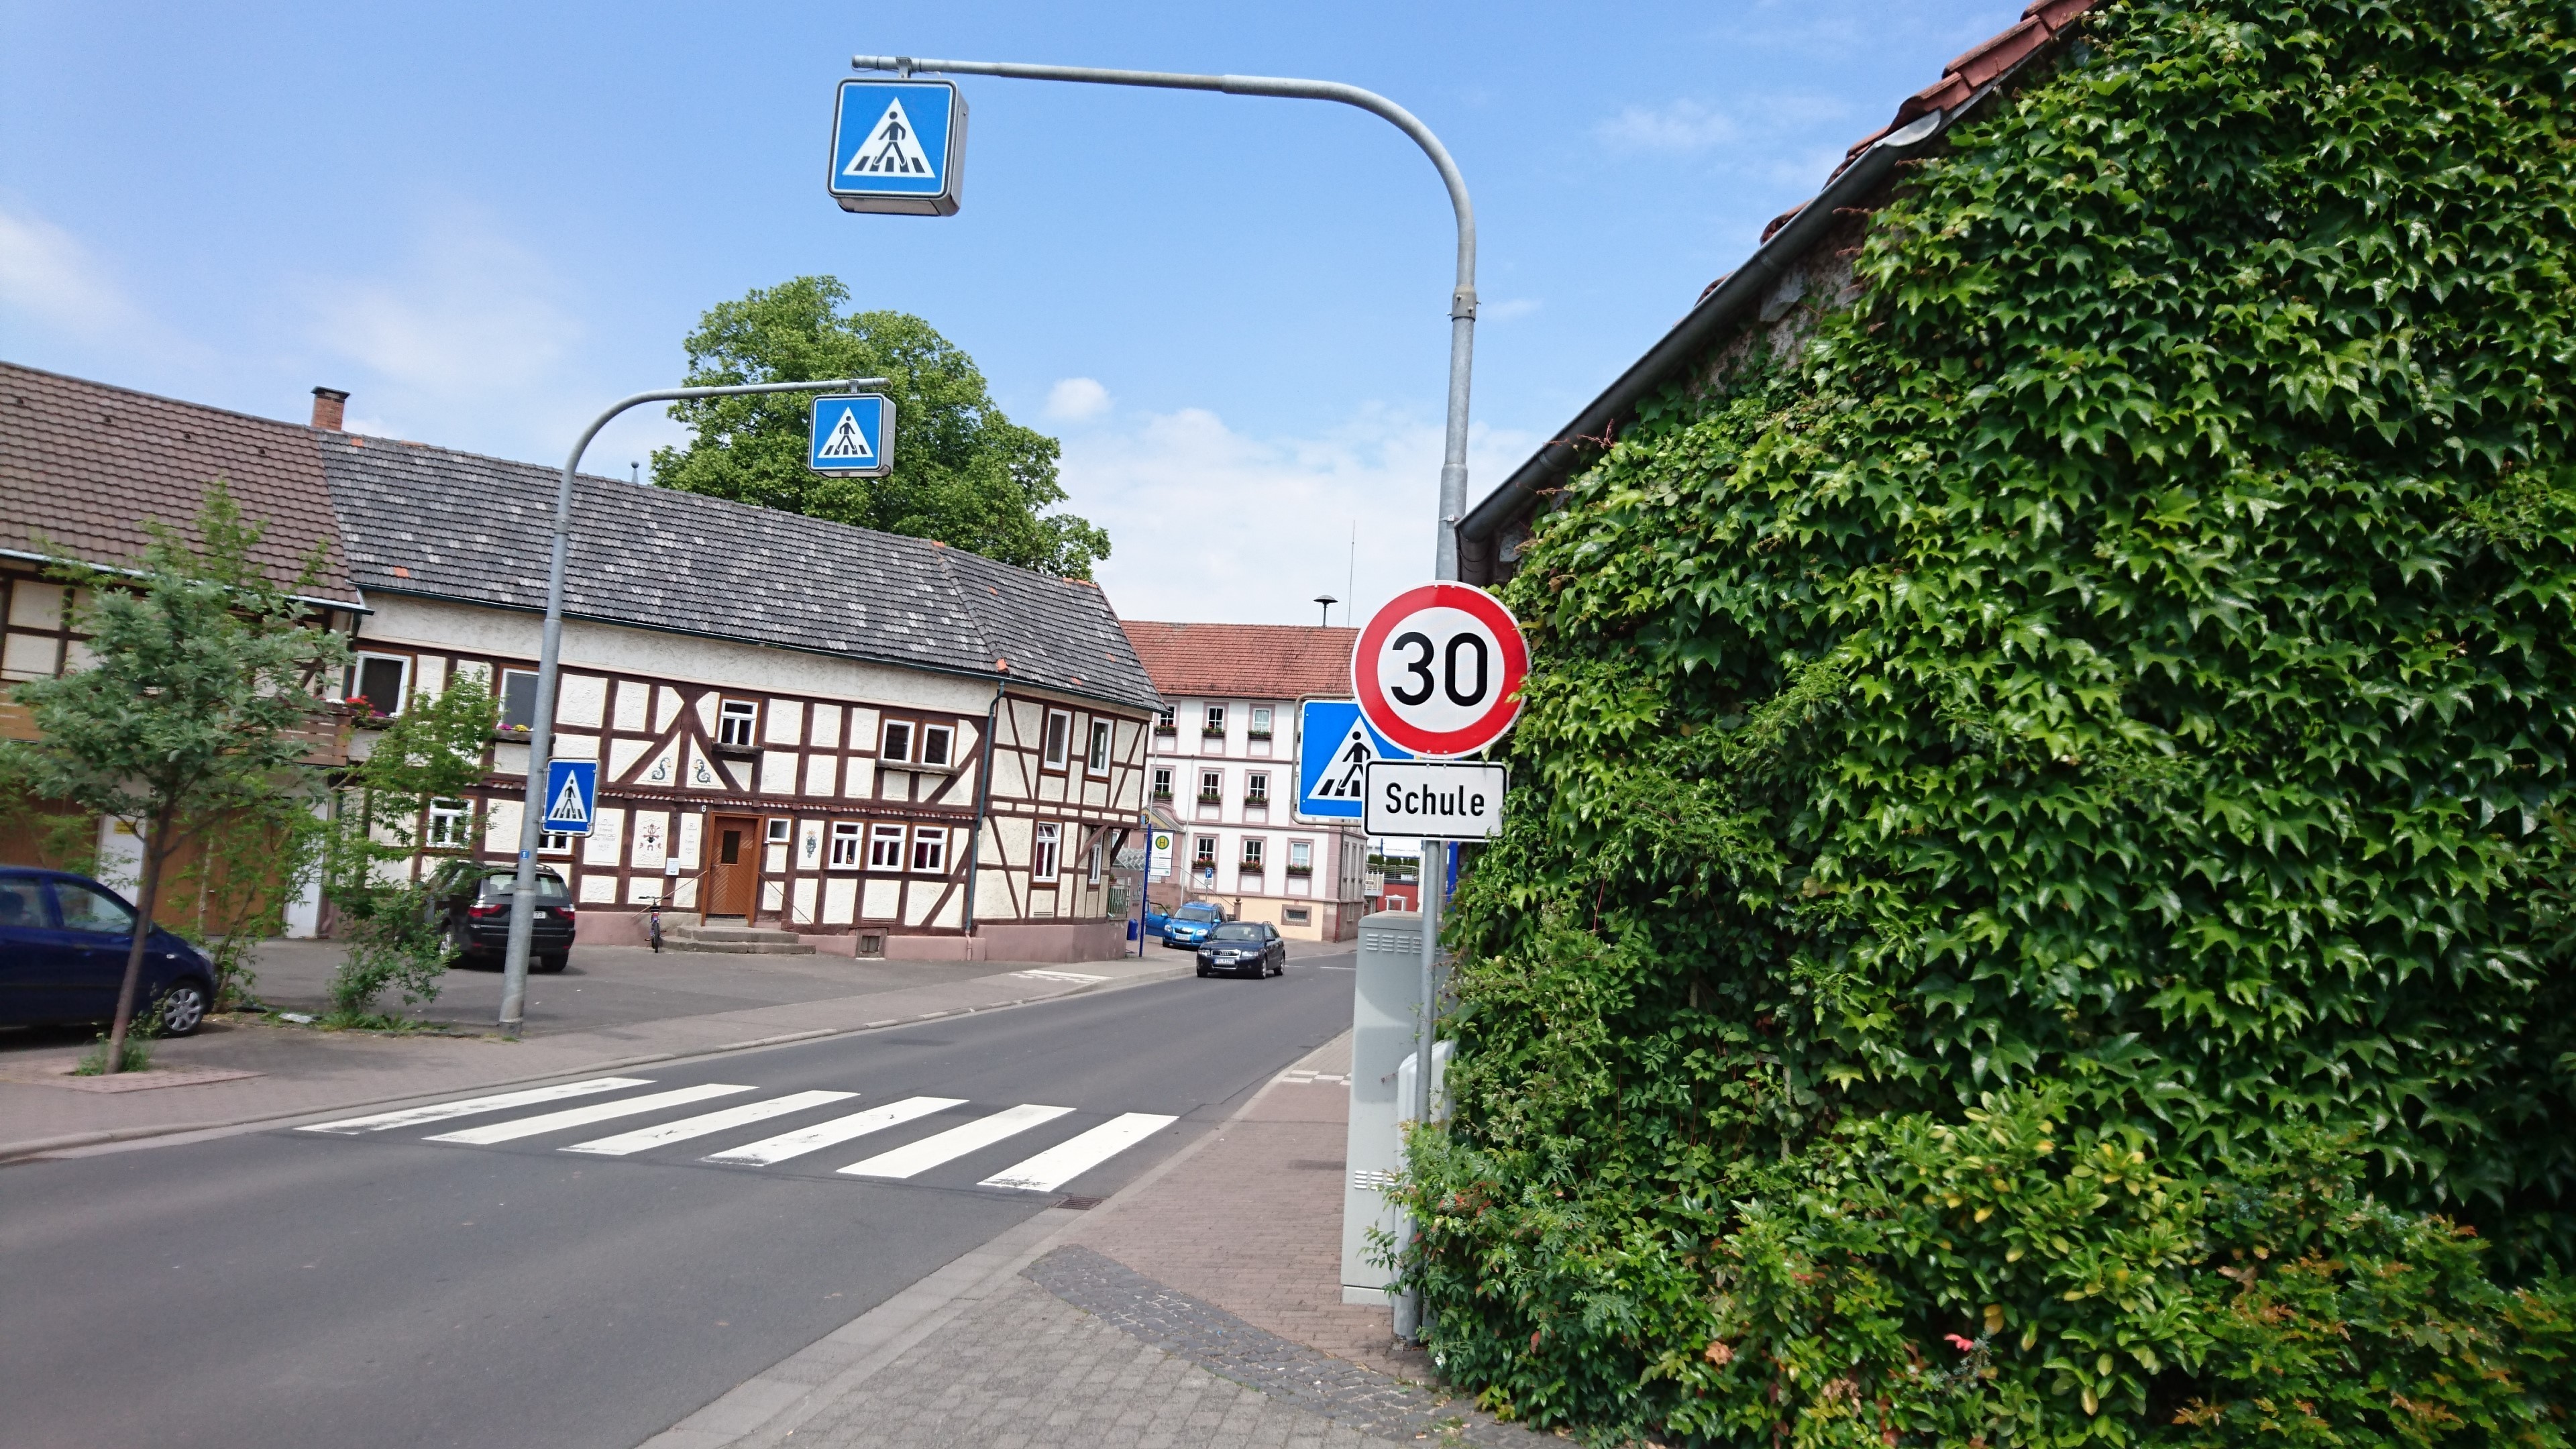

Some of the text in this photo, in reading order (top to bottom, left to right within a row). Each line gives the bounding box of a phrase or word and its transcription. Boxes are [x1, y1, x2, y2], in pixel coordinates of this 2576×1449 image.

[1391, 631, 1488, 707] 30
[1385, 782, 1485, 816] Schule
[1159, 838, 1166, 847] H
[1207, 869, 1211, 877] P
